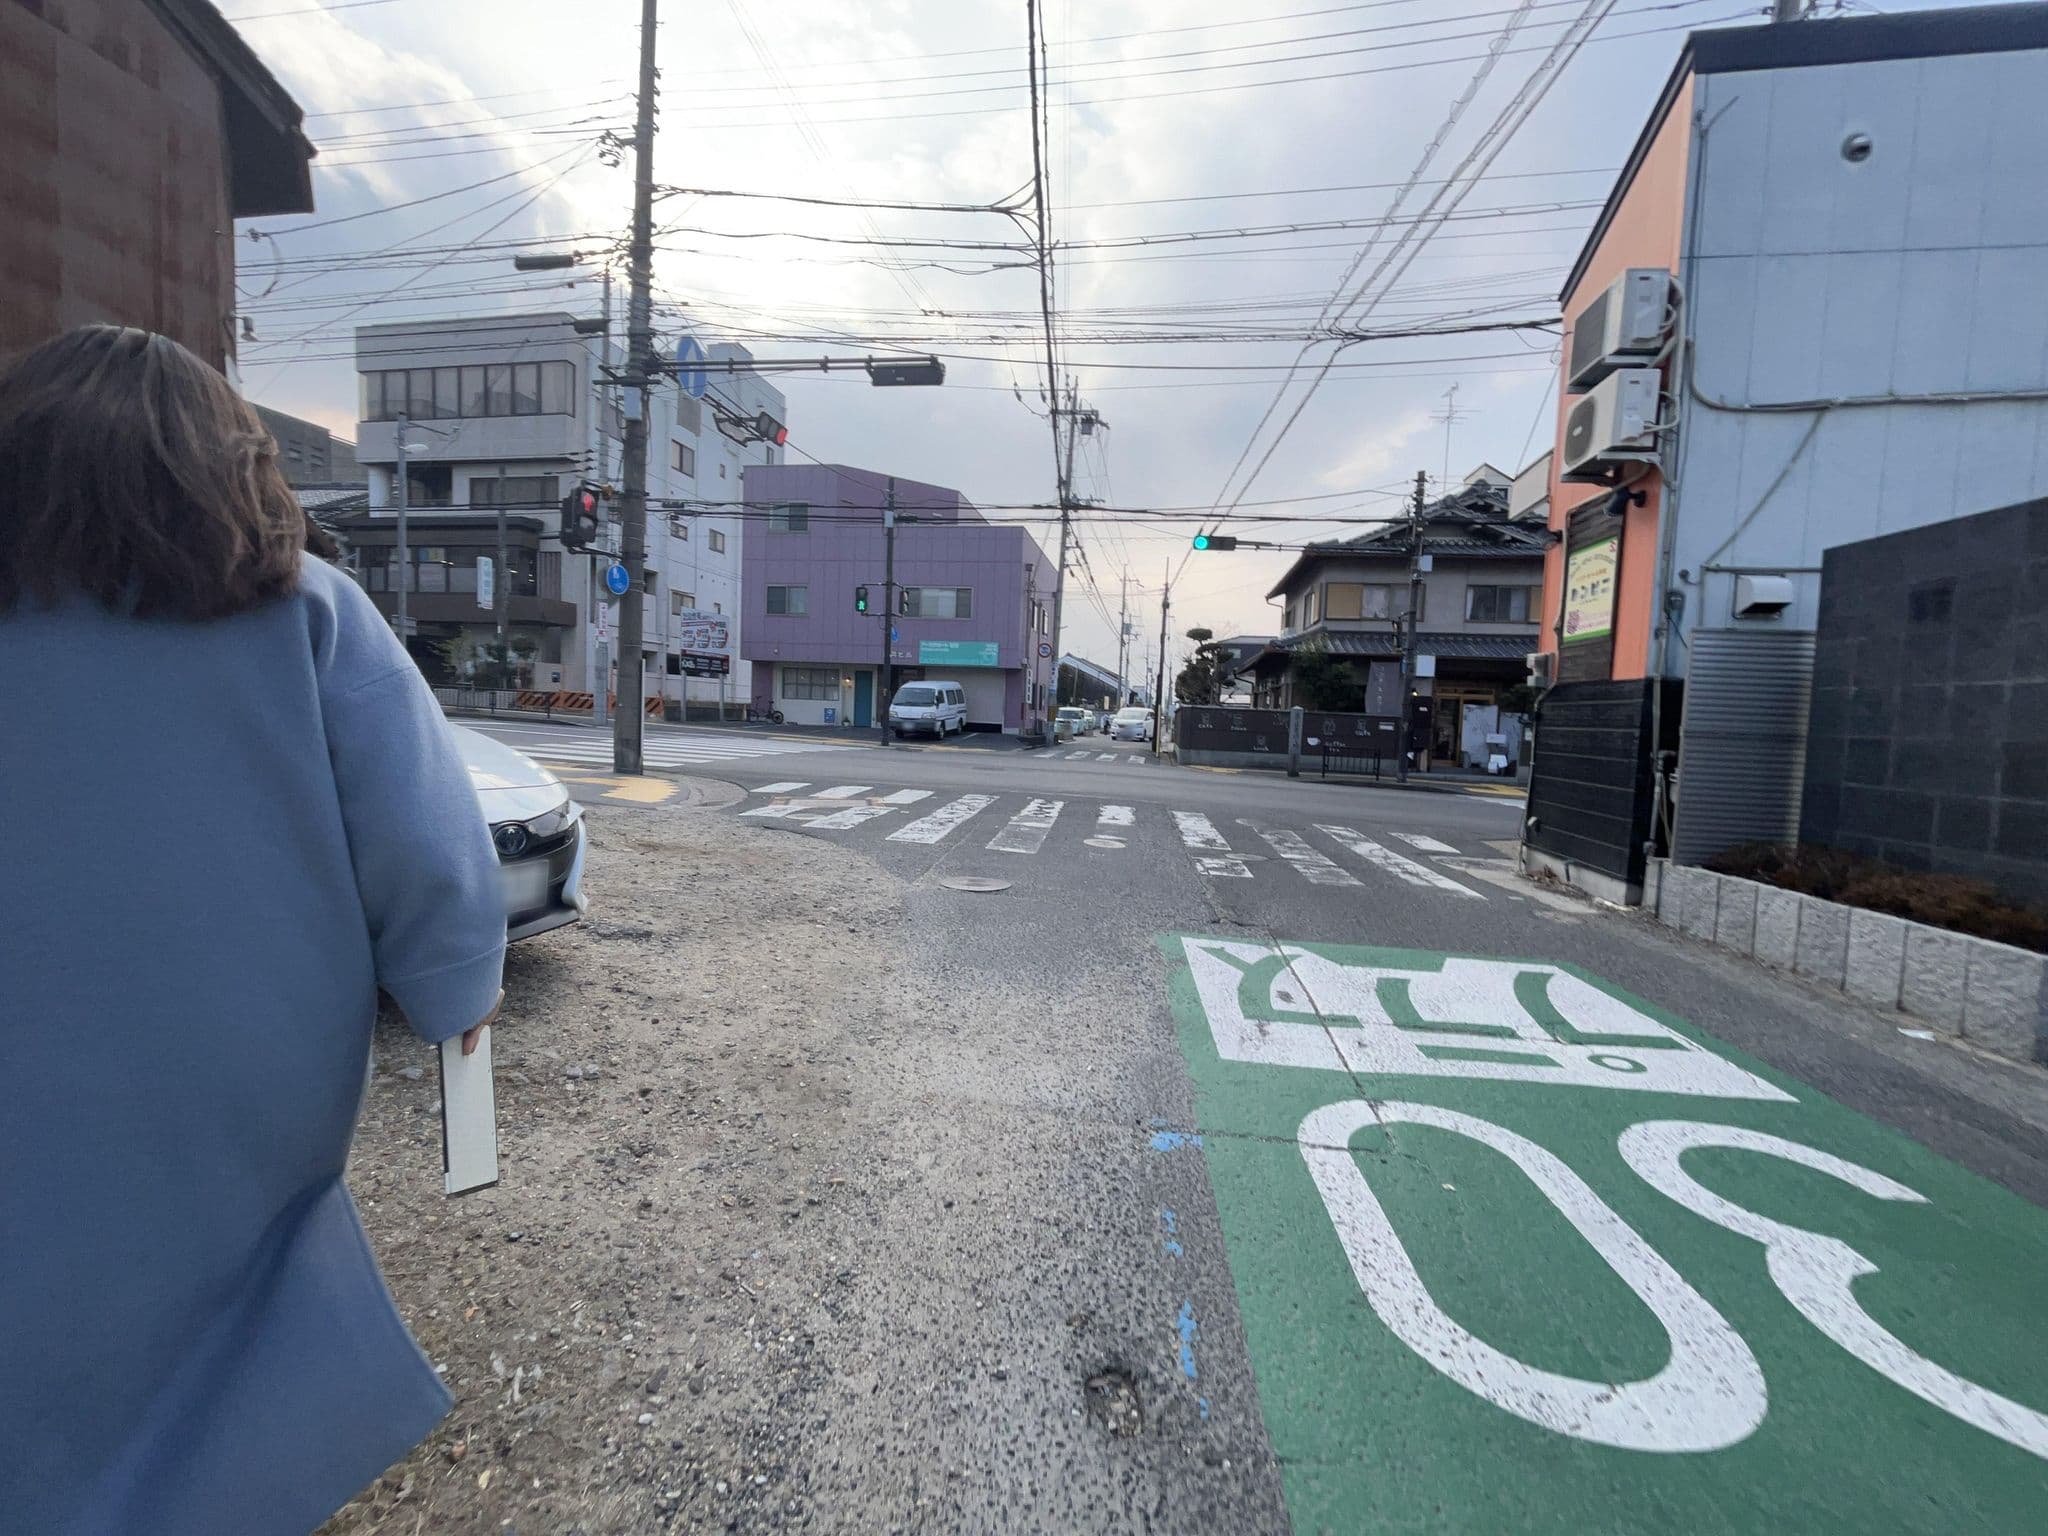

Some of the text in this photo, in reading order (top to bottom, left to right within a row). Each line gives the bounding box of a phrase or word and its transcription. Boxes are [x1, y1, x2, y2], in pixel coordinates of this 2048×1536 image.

[1206, 947, 1692, 1072] プラス
[1297, 1099, 2048, 1460] 30
